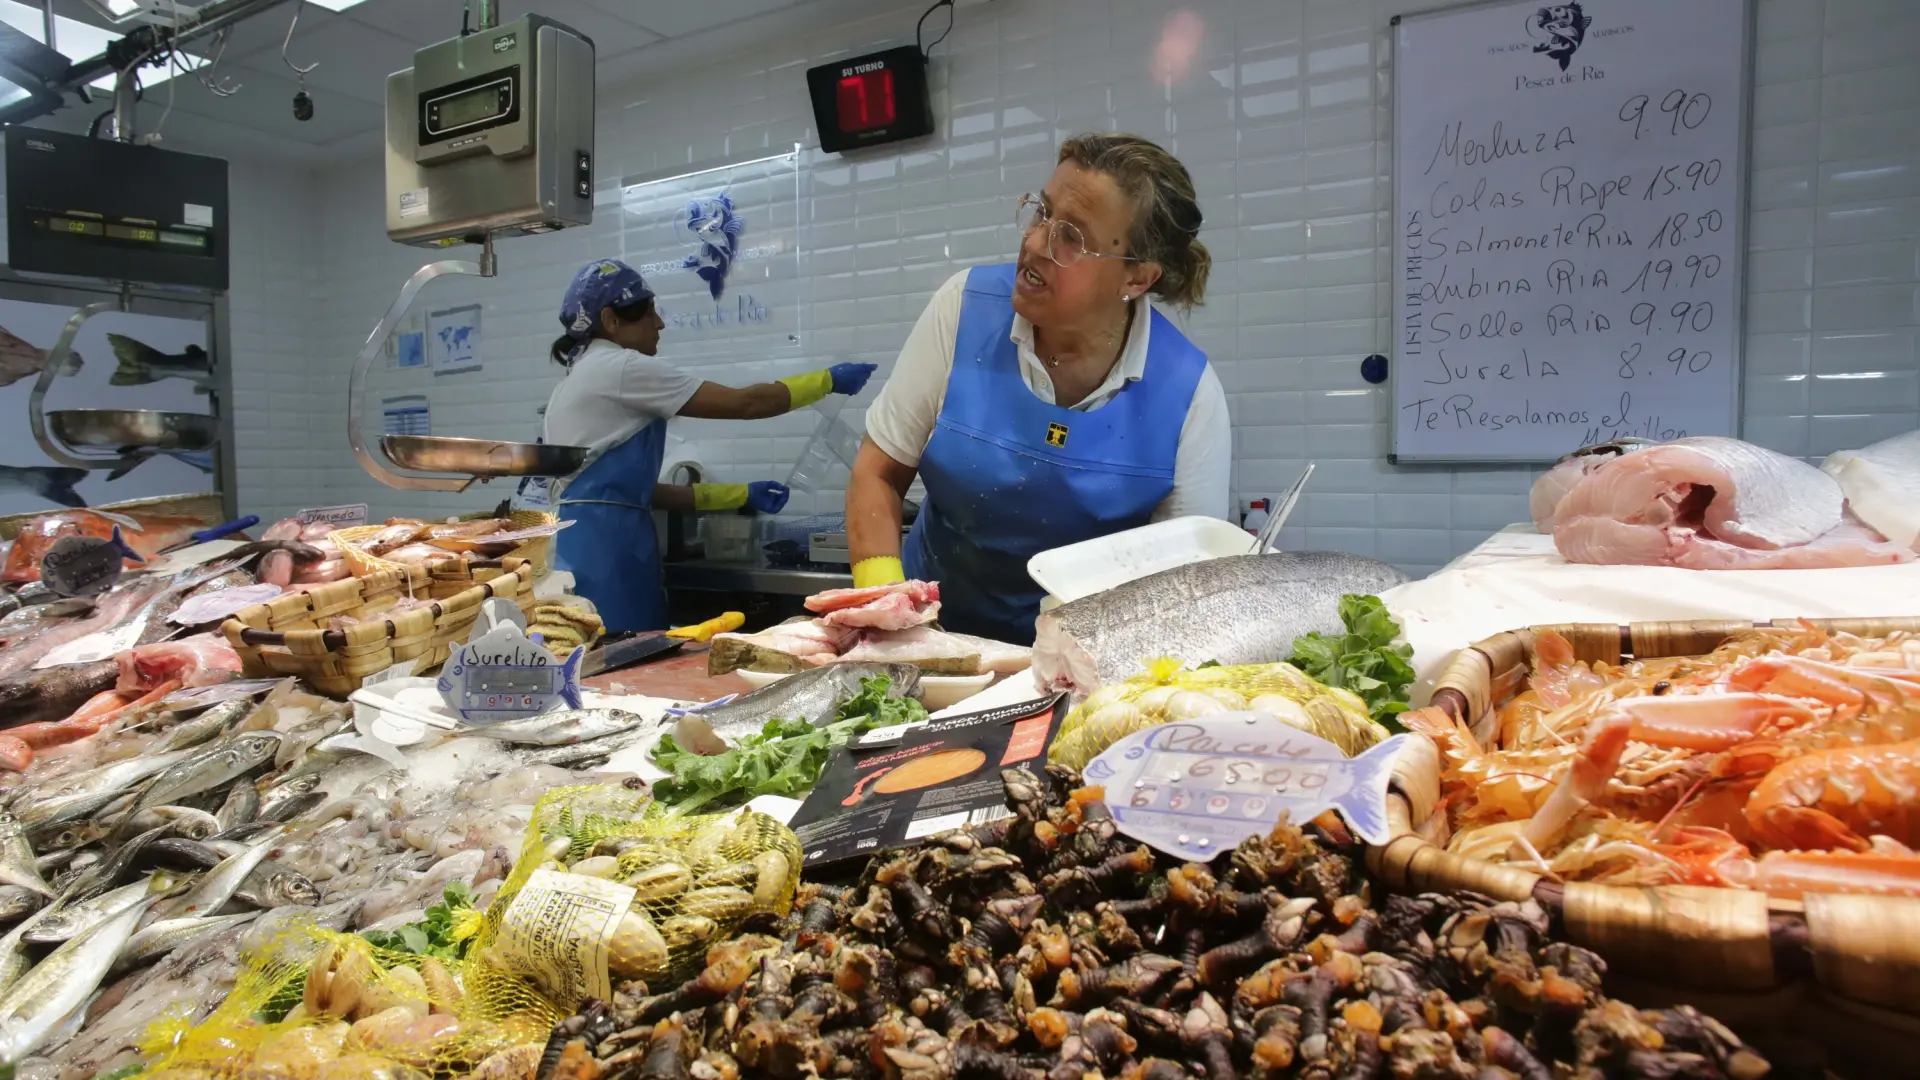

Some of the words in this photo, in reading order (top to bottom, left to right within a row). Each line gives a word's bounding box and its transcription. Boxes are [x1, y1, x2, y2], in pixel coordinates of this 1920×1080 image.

[842, 68, 853, 77] SU
[854, 60, 885, 75] TURNO
[1515, 75, 1555, 90] Pesca
[1560, 72, 1577, 84] de
[1619, 89, 1712, 140] 9.90
[1643, 158, 1722, 201] 15.90
[1648, 209, 1723, 250] 18.50
[1621, 254, 1721, 294] 19.90
[1630, 301, 1713, 336] 9.90
[1618, 342, 1712, 379] 8.90
[1402, 398, 1439, 431] Te
